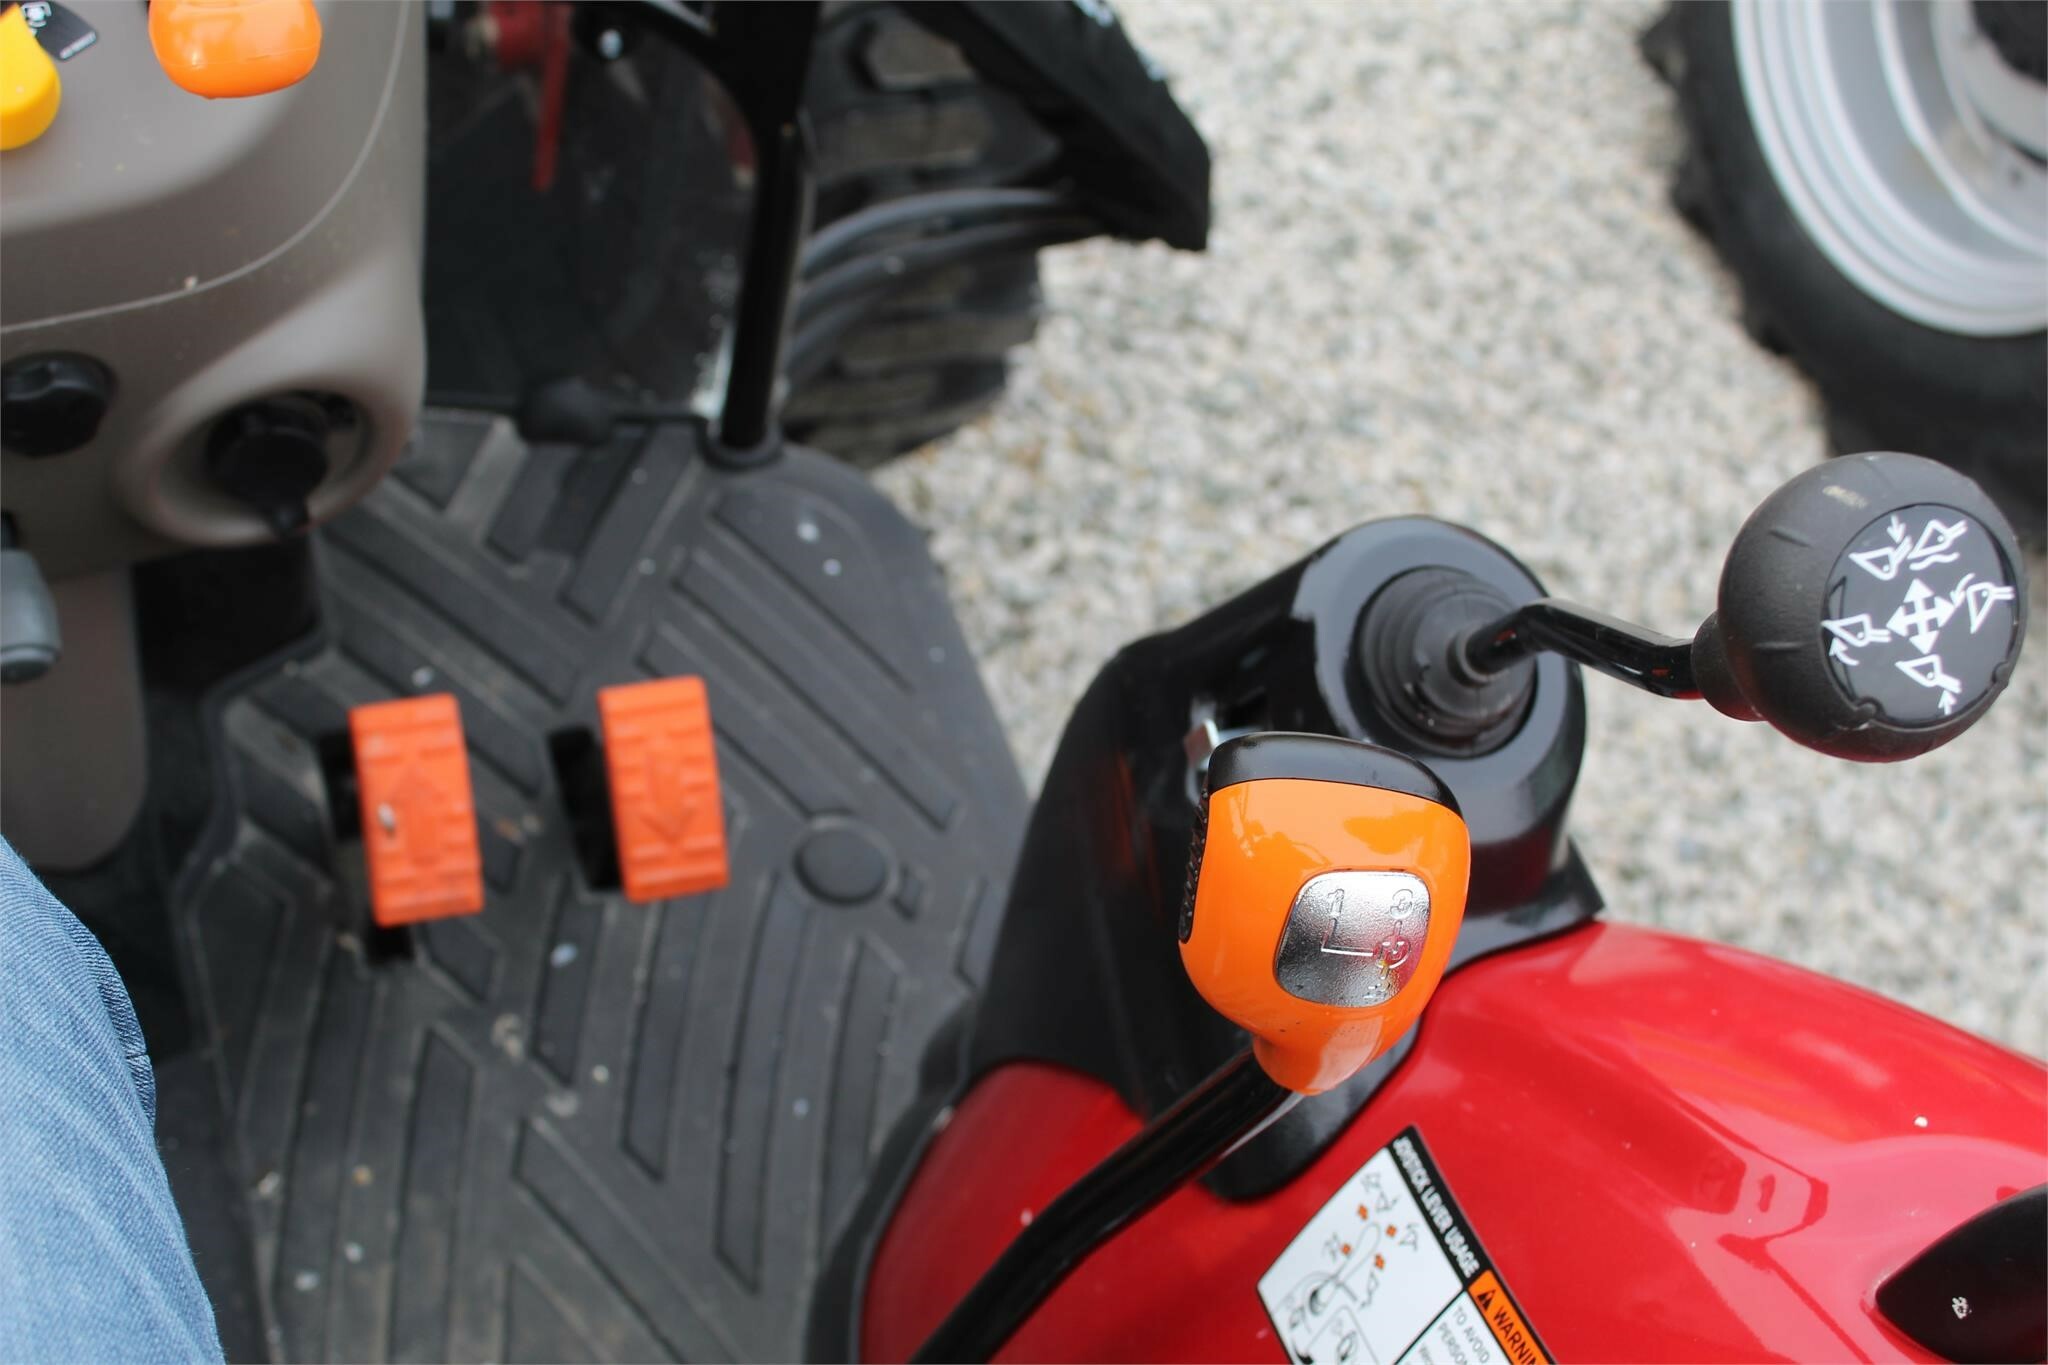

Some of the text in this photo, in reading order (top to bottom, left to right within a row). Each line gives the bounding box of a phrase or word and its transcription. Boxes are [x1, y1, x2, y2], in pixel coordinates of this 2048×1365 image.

[1420, 1185, 1454, 1235] LEVER
[1443, 1226, 1480, 1278] USAGE
[1438, 1322, 1468, 1365] PERSO
[1453, 1306, 1490, 1364] TO AVOID
